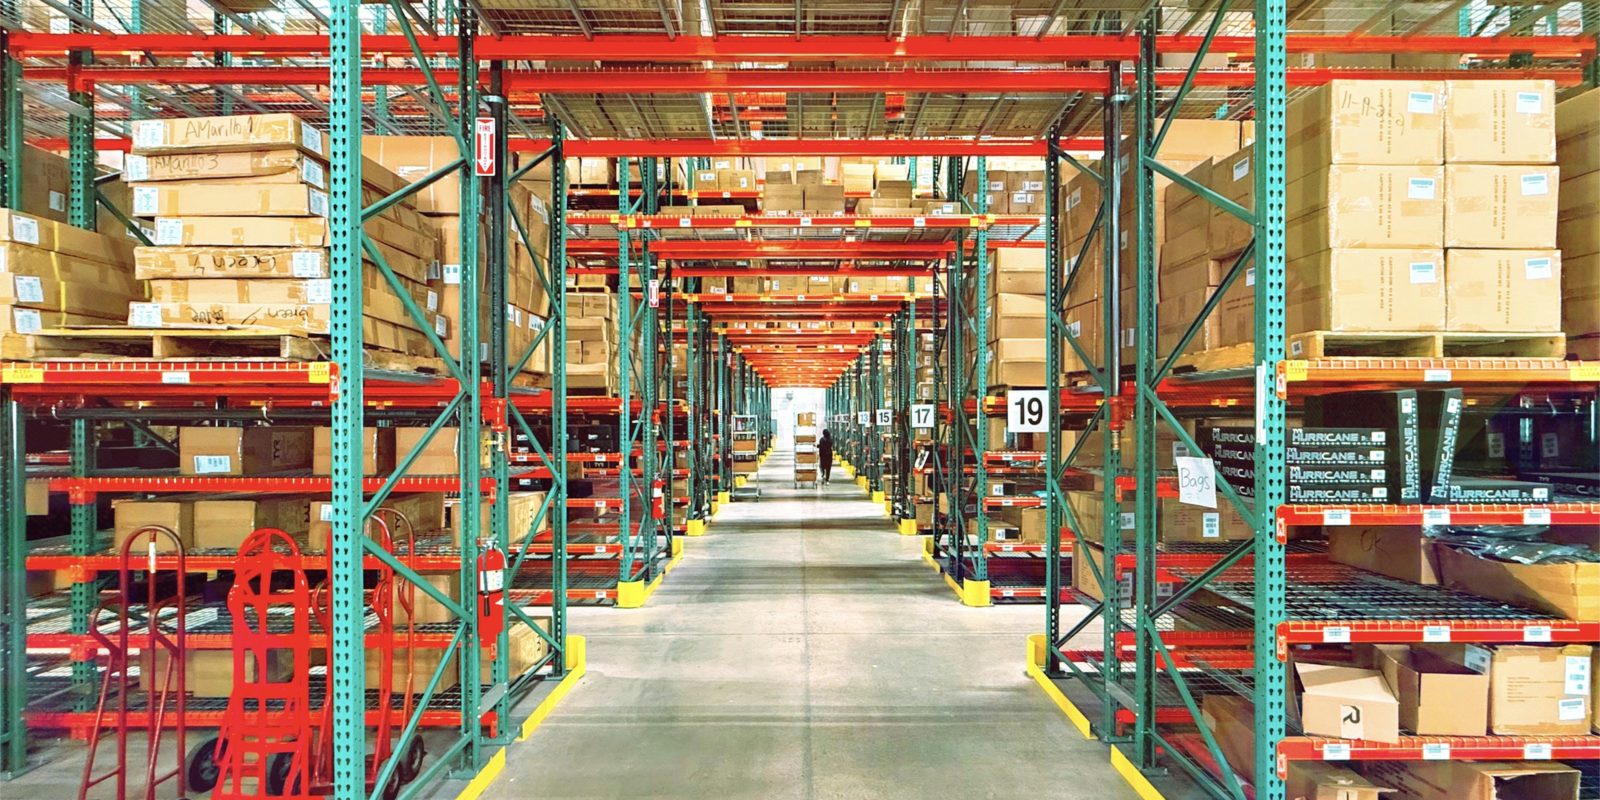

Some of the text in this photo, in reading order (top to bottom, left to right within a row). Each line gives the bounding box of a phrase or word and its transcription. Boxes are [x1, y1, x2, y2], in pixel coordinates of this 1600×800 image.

[914, 408, 930, 424] 17
[1014, 397, 1043, 425] 19
[860, 412, 868, 421] 13
[879, 412, 890, 422] 15
[1212, 432, 1256, 443] HURRICAN
[1292, 432, 1359, 442] HURRICANE
[1214, 449, 1255, 460] HURRICAN
[1286, 452, 1356, 460] HURRICANE
[1404, 428, 1415, 498] HURRICANE
[1436, 427, 1454, 498] HURRICANE
[1180, 468, 1210, 492] Bags
[1290, 470, 1358, 480] HURRICANE
[1290, 490, 1360, 498] HURRICANE
[1450, 490, 1520, 498] HURRICANE
